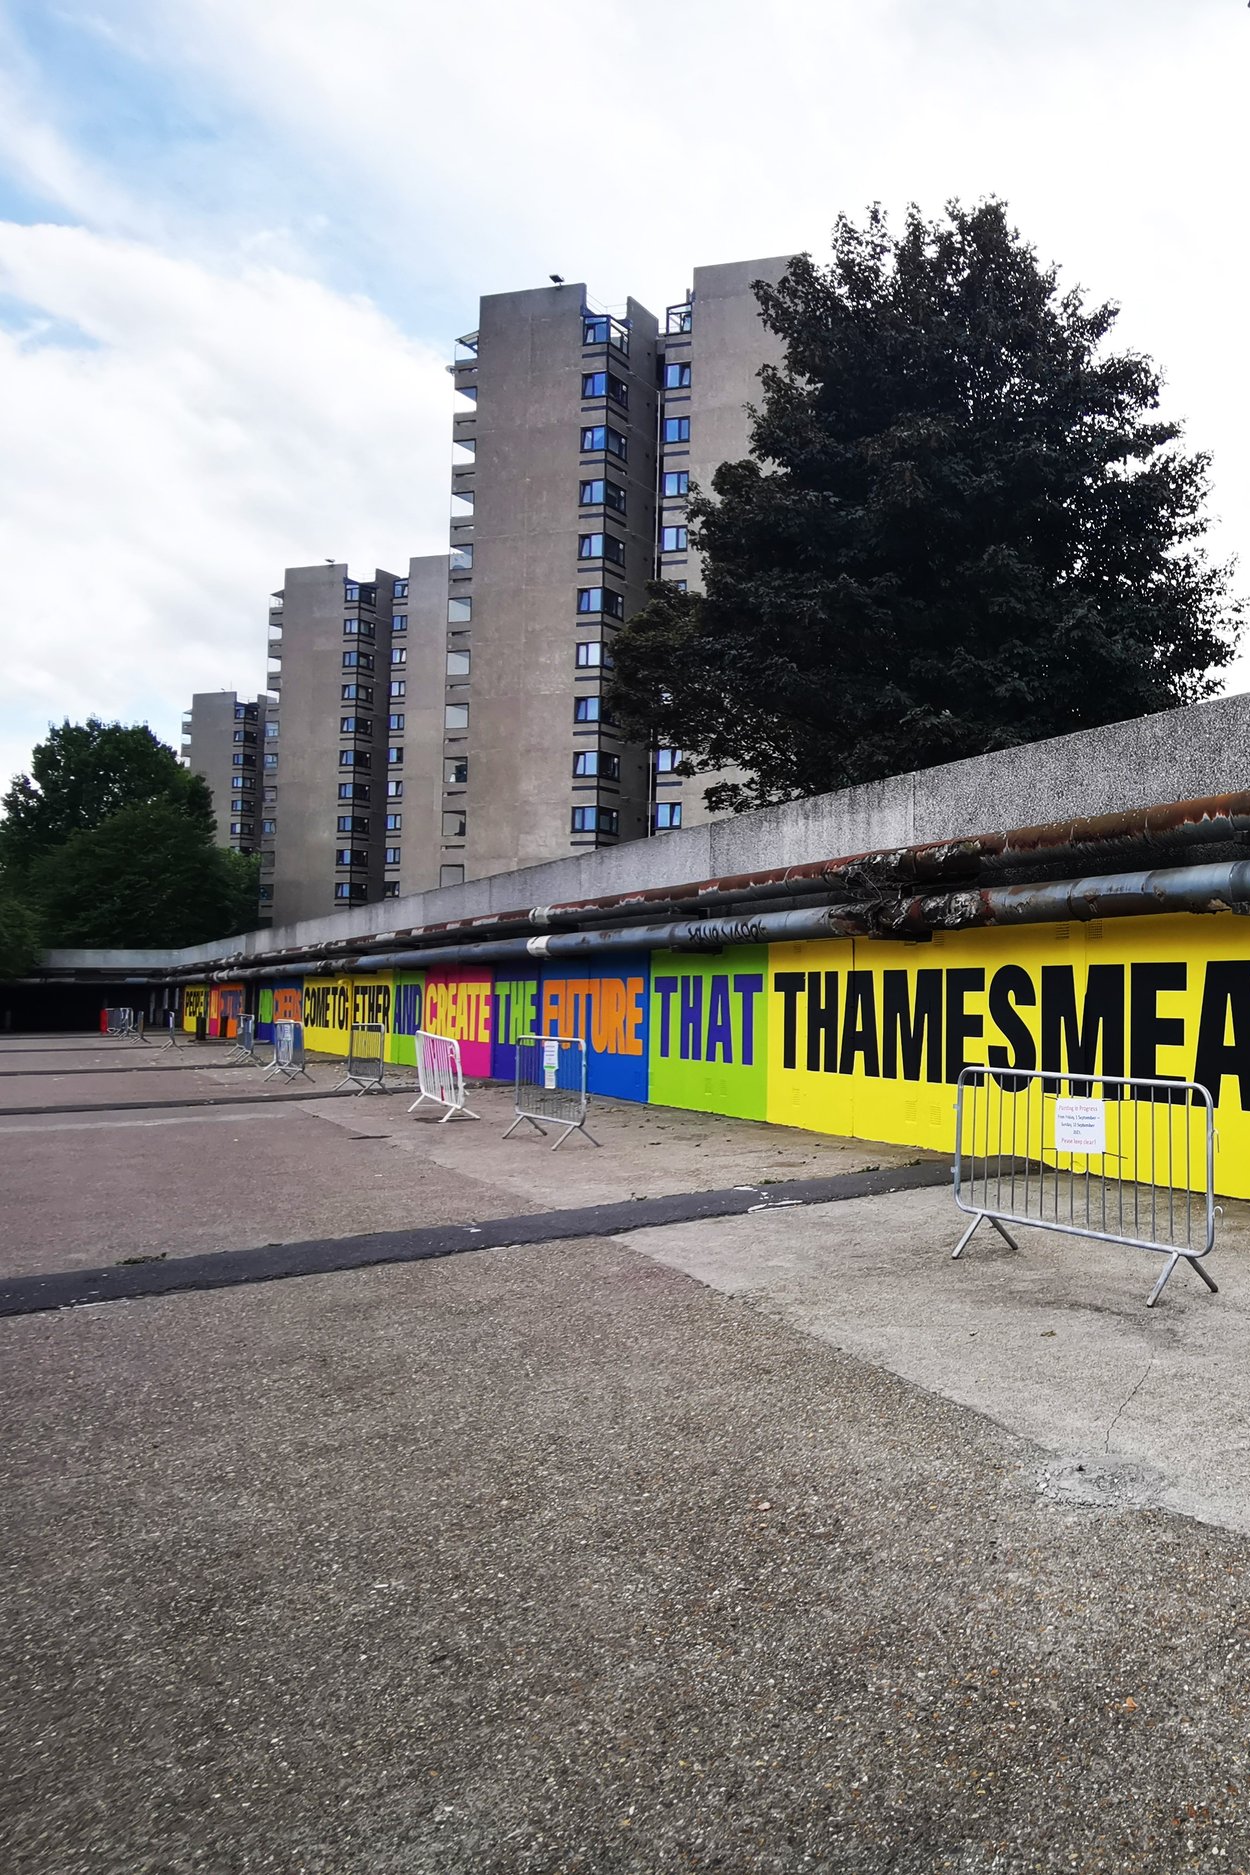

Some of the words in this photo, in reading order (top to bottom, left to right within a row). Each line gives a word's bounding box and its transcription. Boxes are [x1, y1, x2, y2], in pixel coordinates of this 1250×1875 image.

[303, 987, 331, 1028] COME
[394, 984, 422, 1035] AND
[425, 982, 491, 1043] CREATE
[495, 980, 538, 1046] THE
[542, 976, 644, 1055] FUTURE
[654, 973, 764, 1066] THAT
